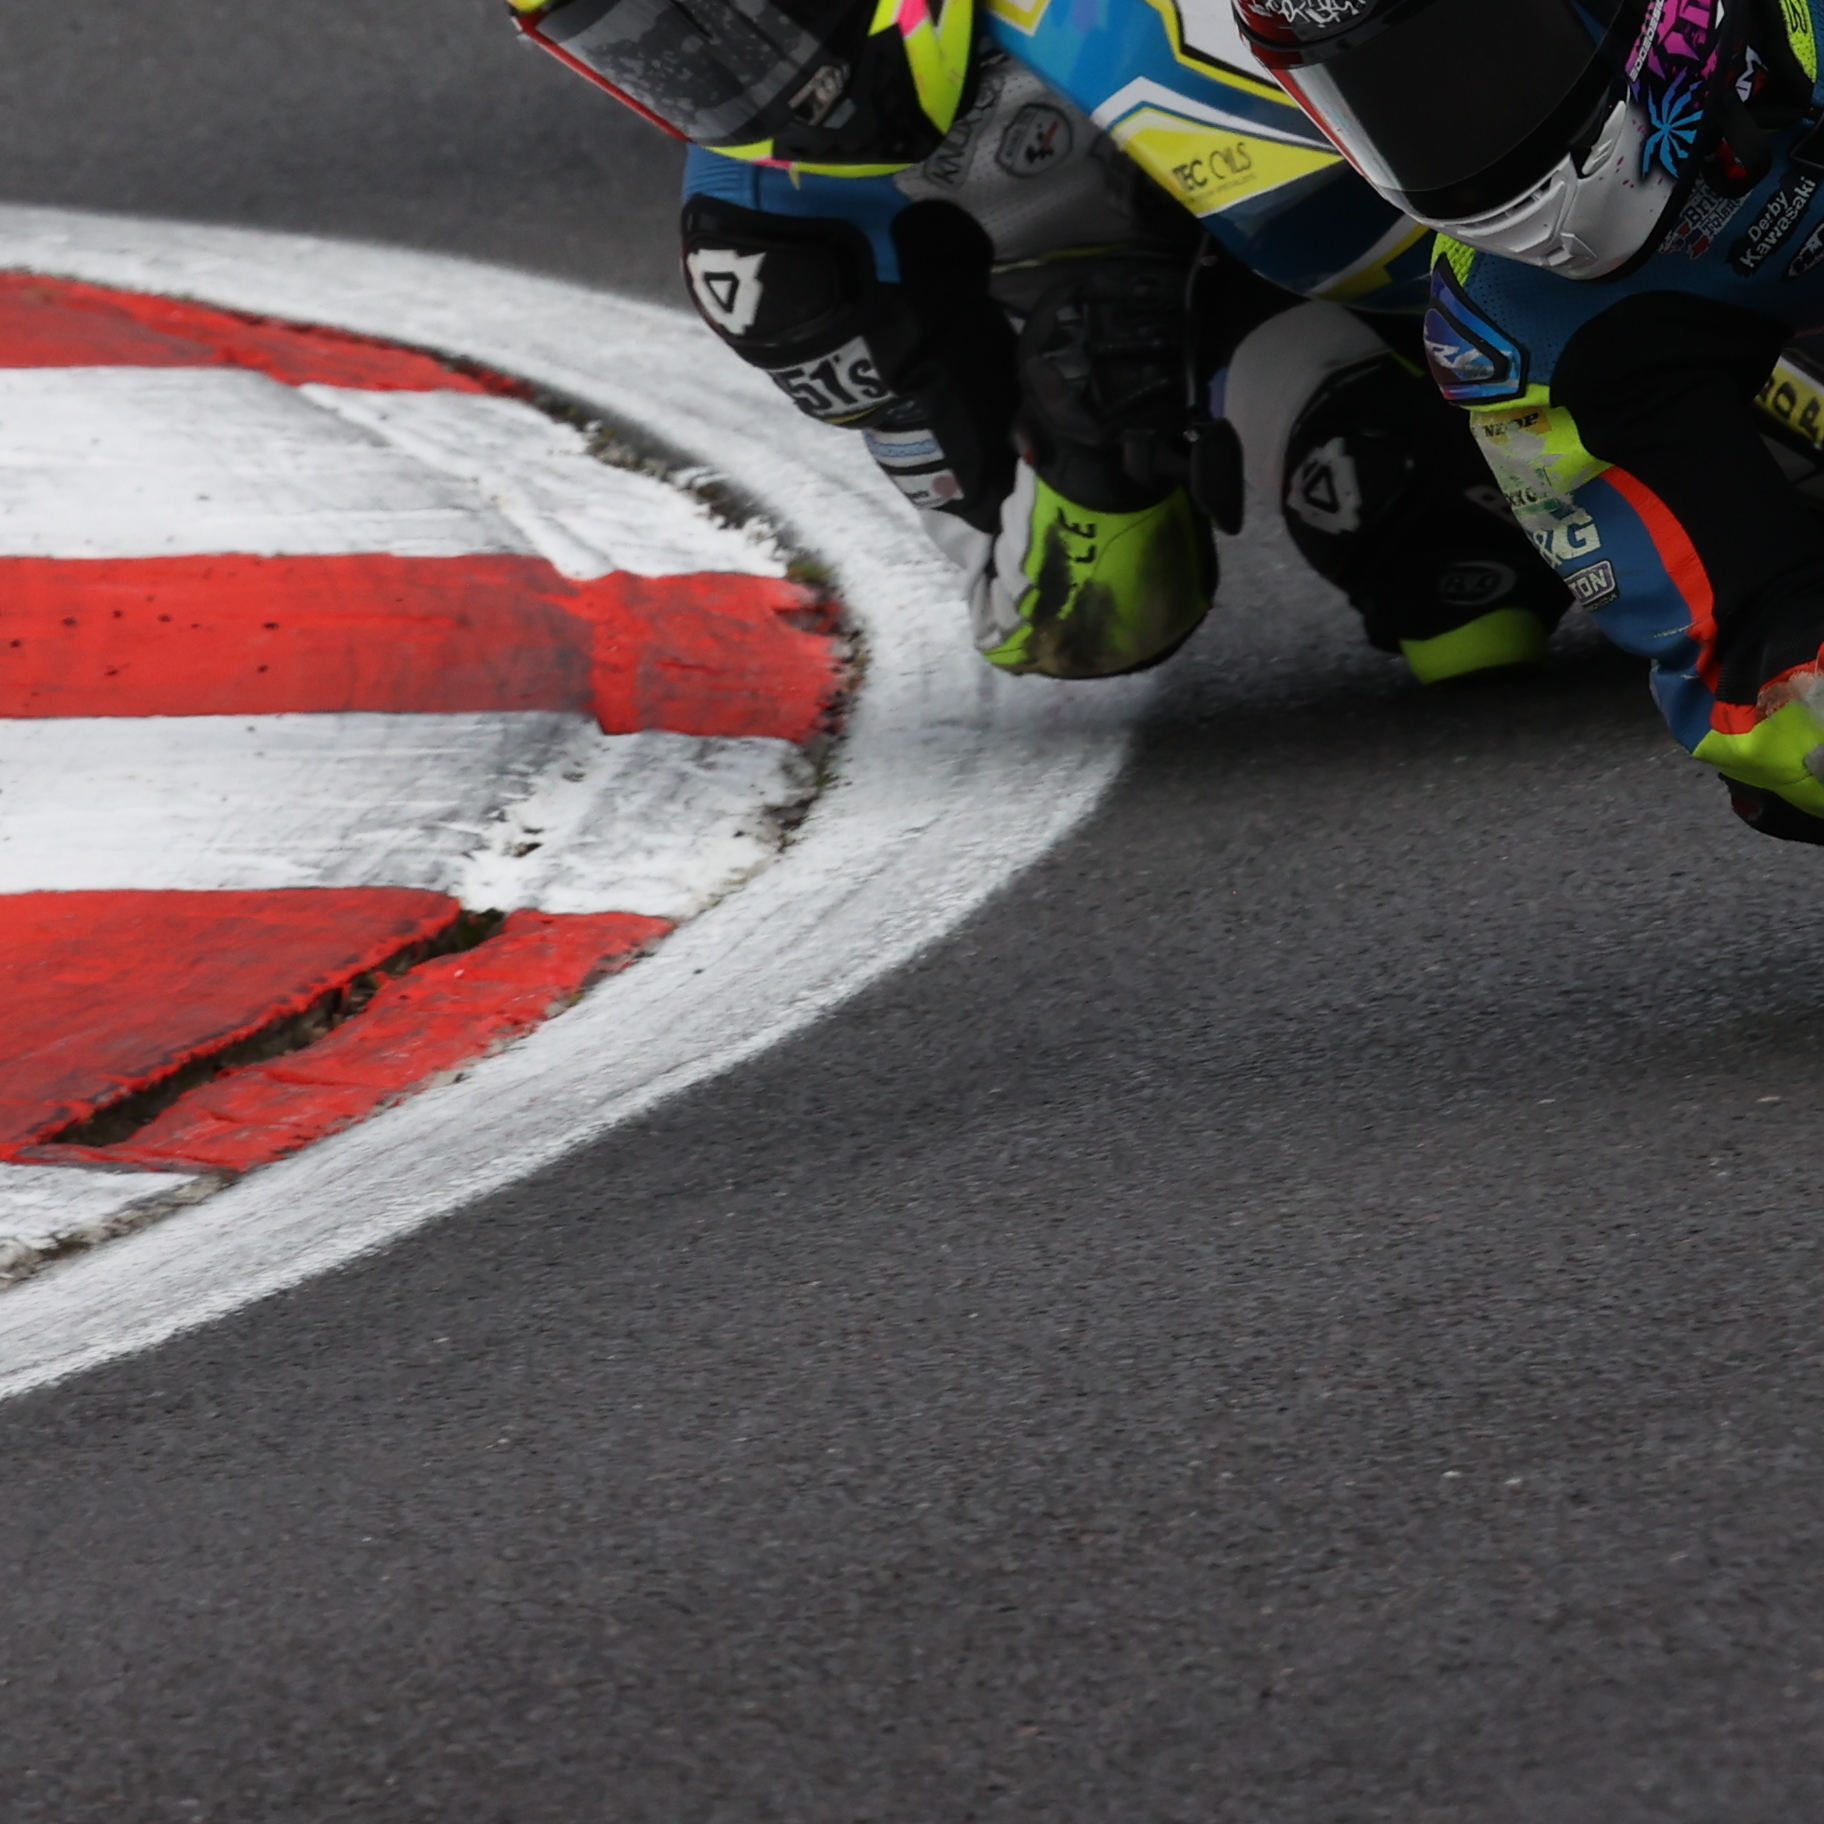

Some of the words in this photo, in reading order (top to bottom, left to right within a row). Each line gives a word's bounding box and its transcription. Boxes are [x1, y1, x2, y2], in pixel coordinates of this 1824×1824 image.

[1739, 176, 1817, 270] Kawasaki
[1747, 188, 1788, 244] Derby
[1533, 508, 1602, 572] &G
